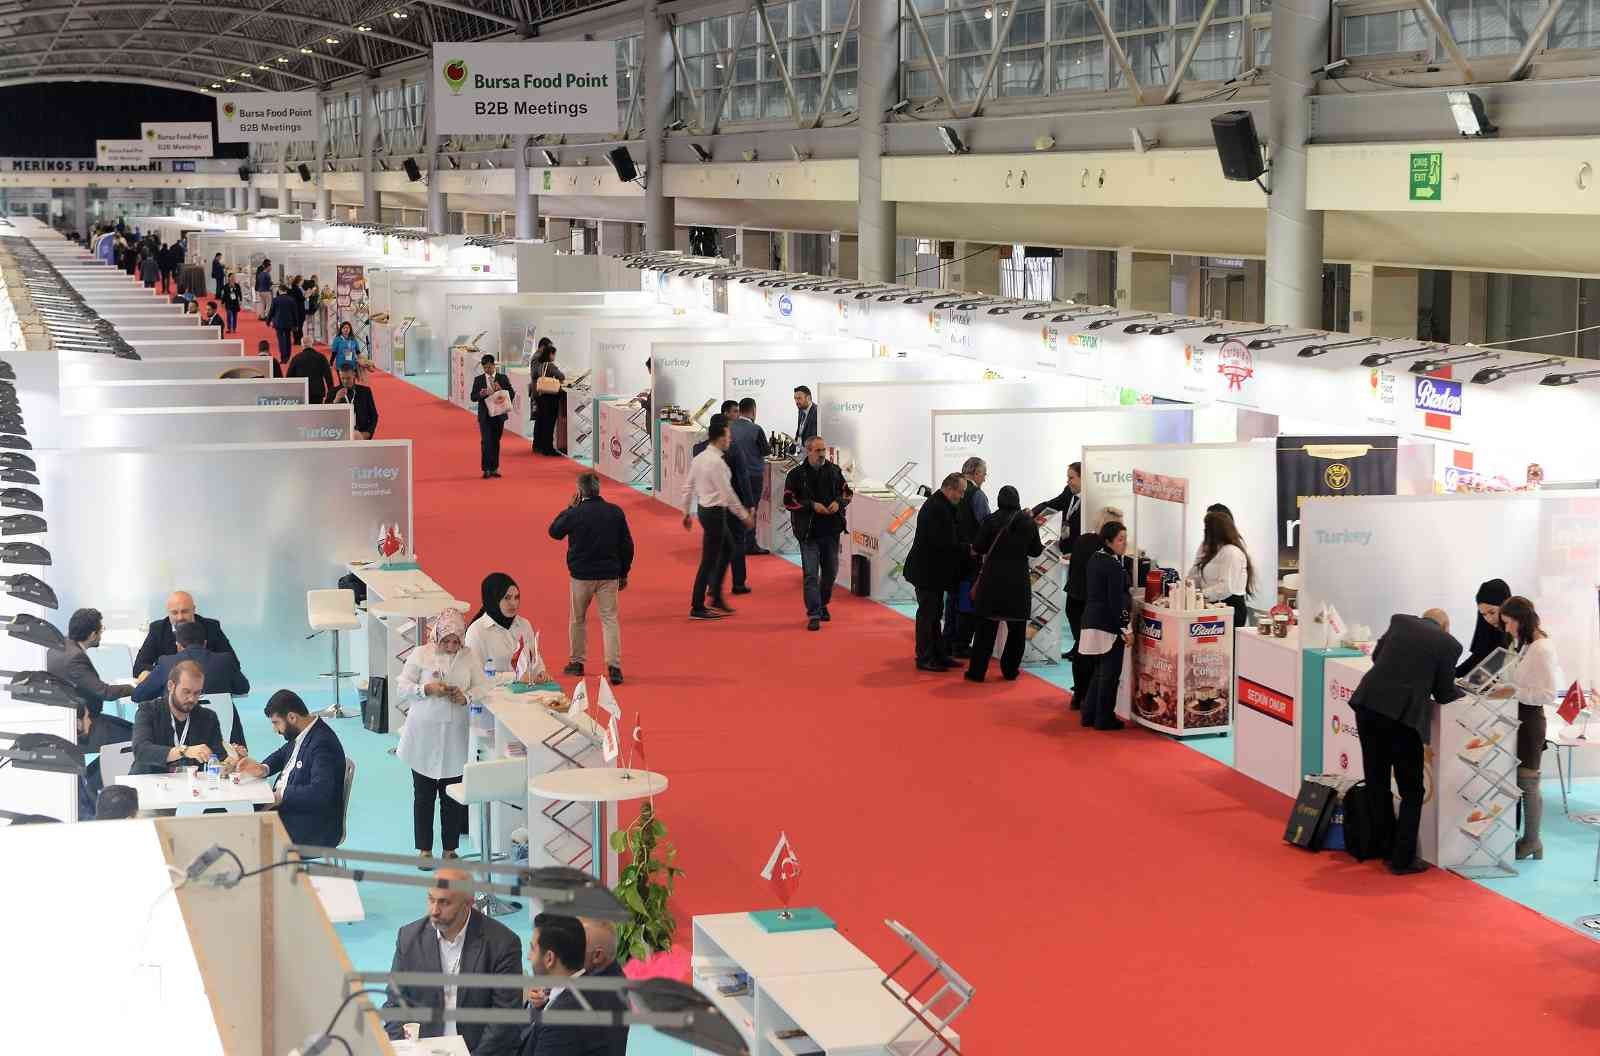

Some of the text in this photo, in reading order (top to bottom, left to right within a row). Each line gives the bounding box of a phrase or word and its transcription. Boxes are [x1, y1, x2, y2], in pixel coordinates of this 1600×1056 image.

[474, 72, 608, 89] Bursa Food Point
[240, 108, 312, 118] Bursa Food Point
[475, 101, 588, 117] B2B Meetings
[240, 123, 301, 133] B2B Meetings
[658, 358, 690, 368] Turkey
[732, 377, 766, 387] Turkey
[297, 426, 343, 440] Turkey
[942, 432, 984, 444] Turkey
[349, 465, 400, 481] Turkey
[1094, 471, 1134, 483] Turke
[1314, 529, 1373, 546] Turkey
